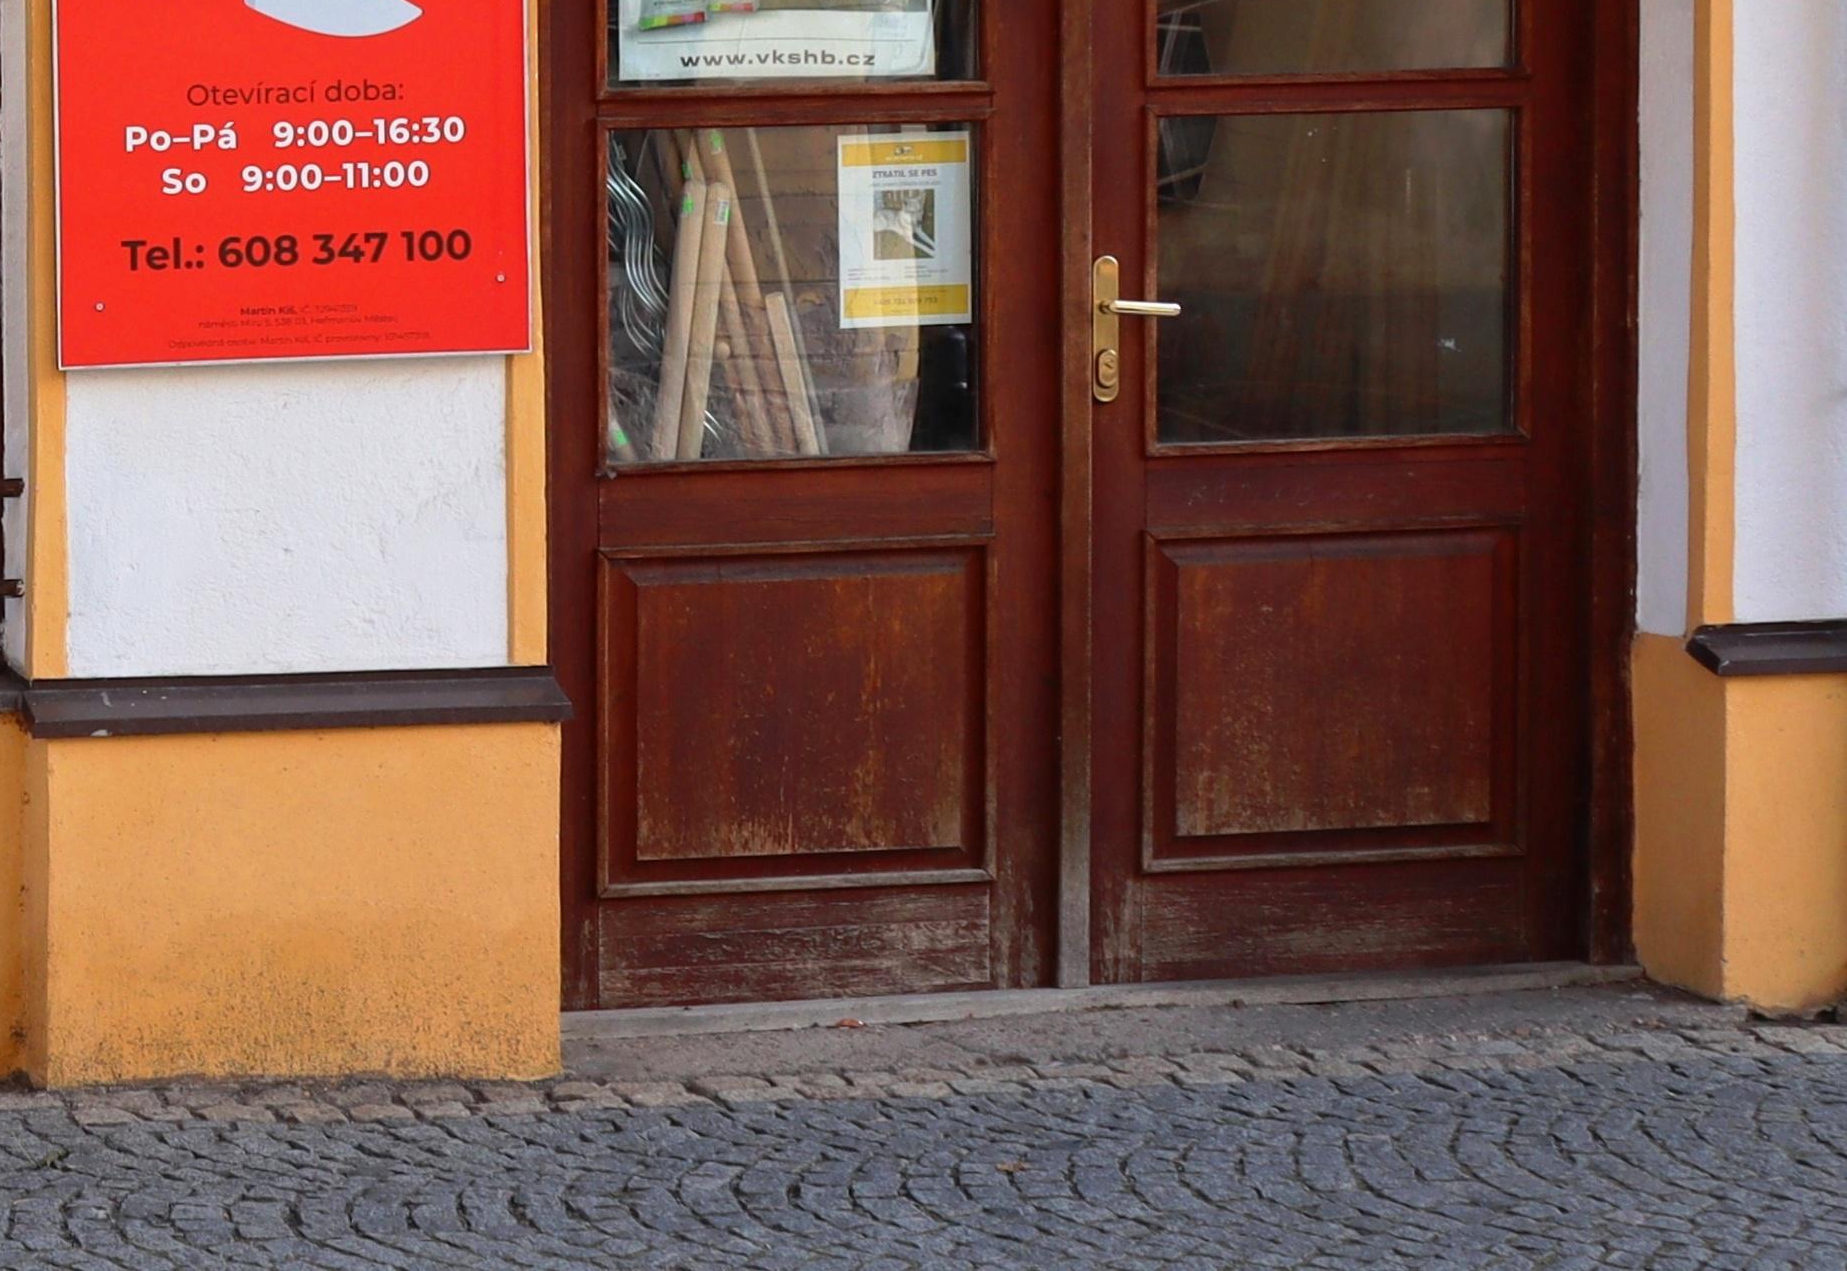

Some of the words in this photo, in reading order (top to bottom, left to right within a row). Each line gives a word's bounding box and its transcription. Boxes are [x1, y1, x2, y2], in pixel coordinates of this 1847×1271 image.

[680, 50, 876, 68] www.vkshb.cz
[186, 80, 315, 107] Otevírací
[324, 79, 404, 103] doba:
[161, 168, 207, 195] So
[121, 237, 205, 271] Tel.:
[217, 235, 299, 269] 608
[312, 232, 388, 265] 347
[401, 229, 472, 262] 100
